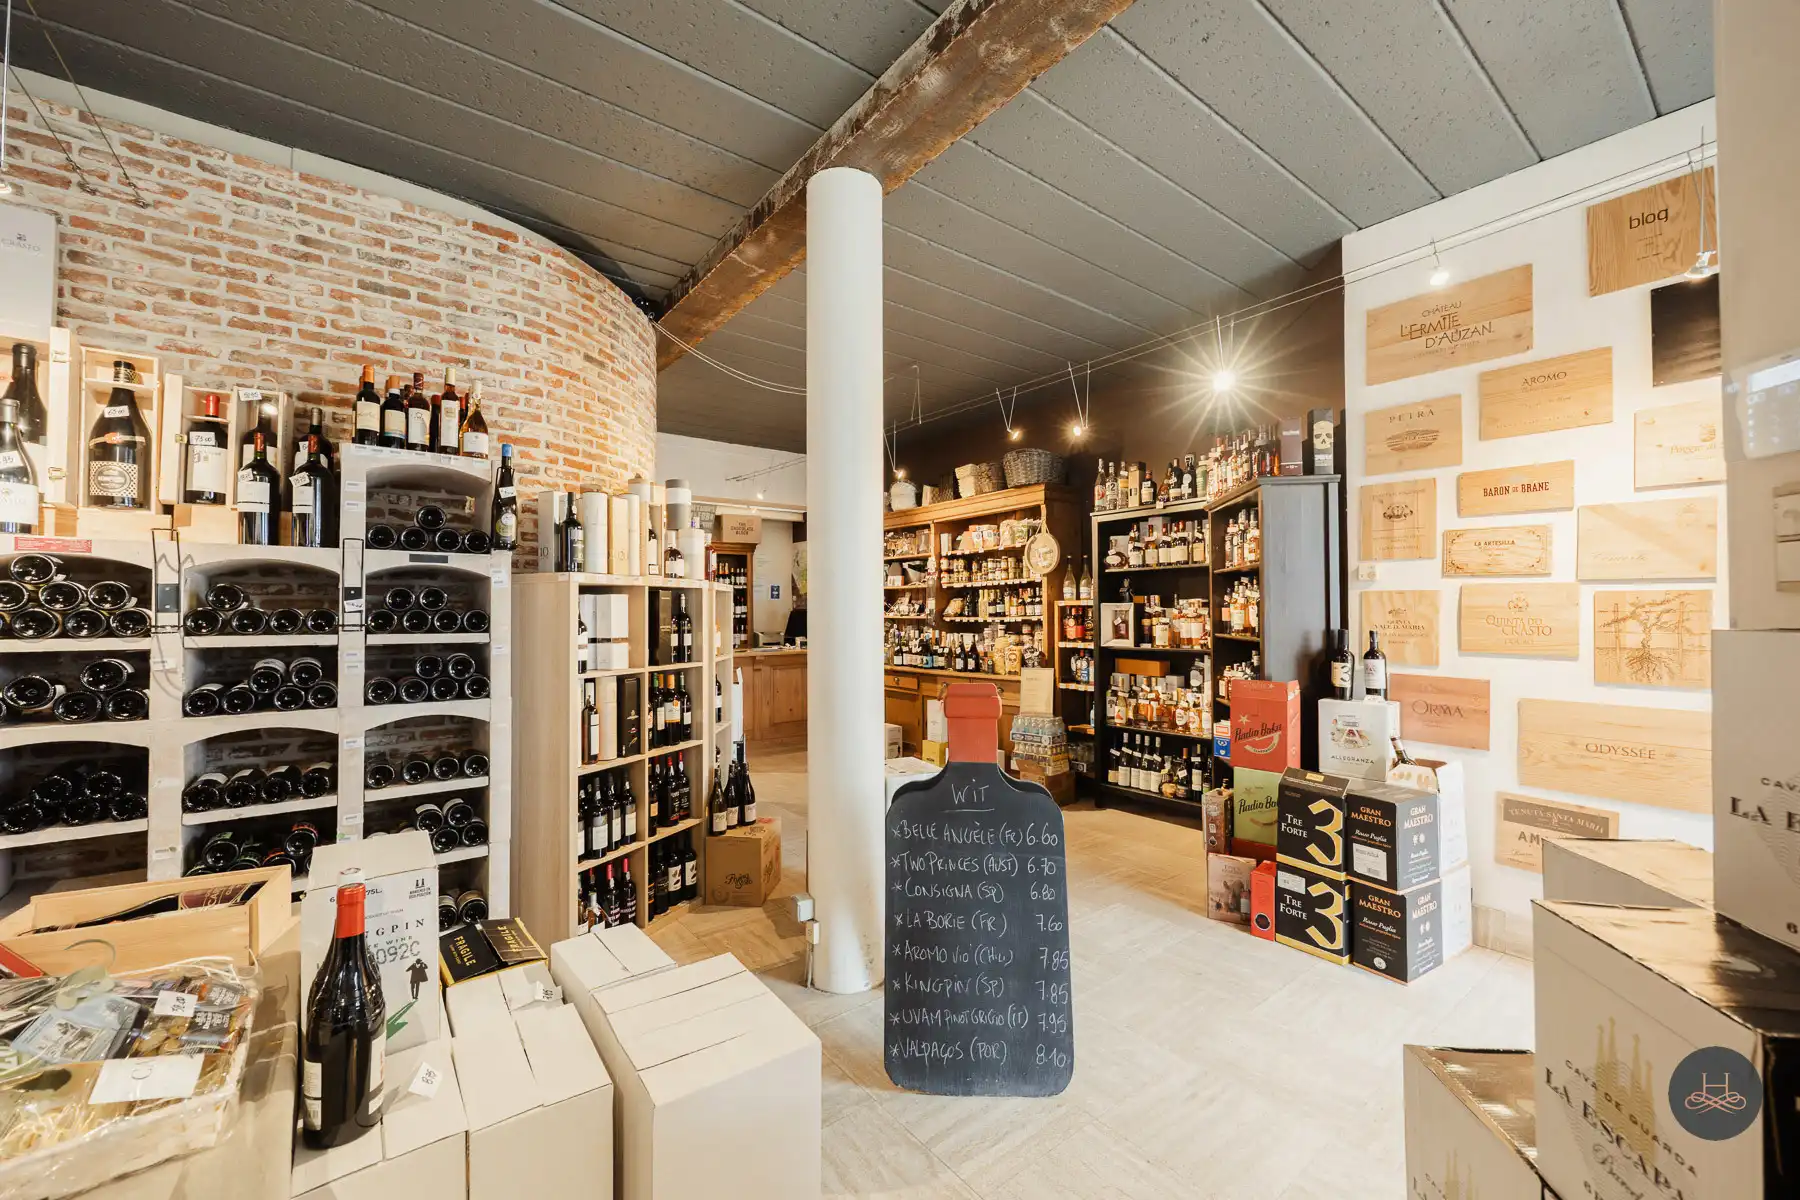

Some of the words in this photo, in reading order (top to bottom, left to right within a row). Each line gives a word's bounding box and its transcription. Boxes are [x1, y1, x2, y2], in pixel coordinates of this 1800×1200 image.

[1521, 372, 1568, 386] AROMO
[1483, 486, 1510, 497] BARON
[1521, 482, 1550, 494] BRANE
[1485, 615, 1525, 627] QUINTA
[1502, 623, 1552, 637] CRASTO
[1412, 701, 1464, 718] ORMA
[1234, 727, 1259, 743] Radio
[1238, 798, 1264, 814] Radio
[1360, 806, 1381, 817] GRAN
[1351, 812, 1391, 827] MAESTRO
[1404, 814, 1434, 829] MAESTRO
[1026, 822, 1059, 846] 6.60
[1307, 799, 1343, 866] 3
[1517, 831, 1541, 848] AM
[1027, 856, 1056, 874] 6.70
[1359, 899, 1401, 918] MAESTRO
[1368, 894, 1391, 907] GRAN
[1307, 882, 1343, 950] 3
[1412, 900, 1437, 919] MAESTRO
[453, 935, 477, 966] FRAGILE
[904, 940, 948, 964] AROMO
[1039, 947, 1069, 970] 7.85
[1035, 980, 1069, 1005] 7.85
[1037, 1012, 1068, 1034] 7.95
[1603, 1091, 1622, 1113] DE
